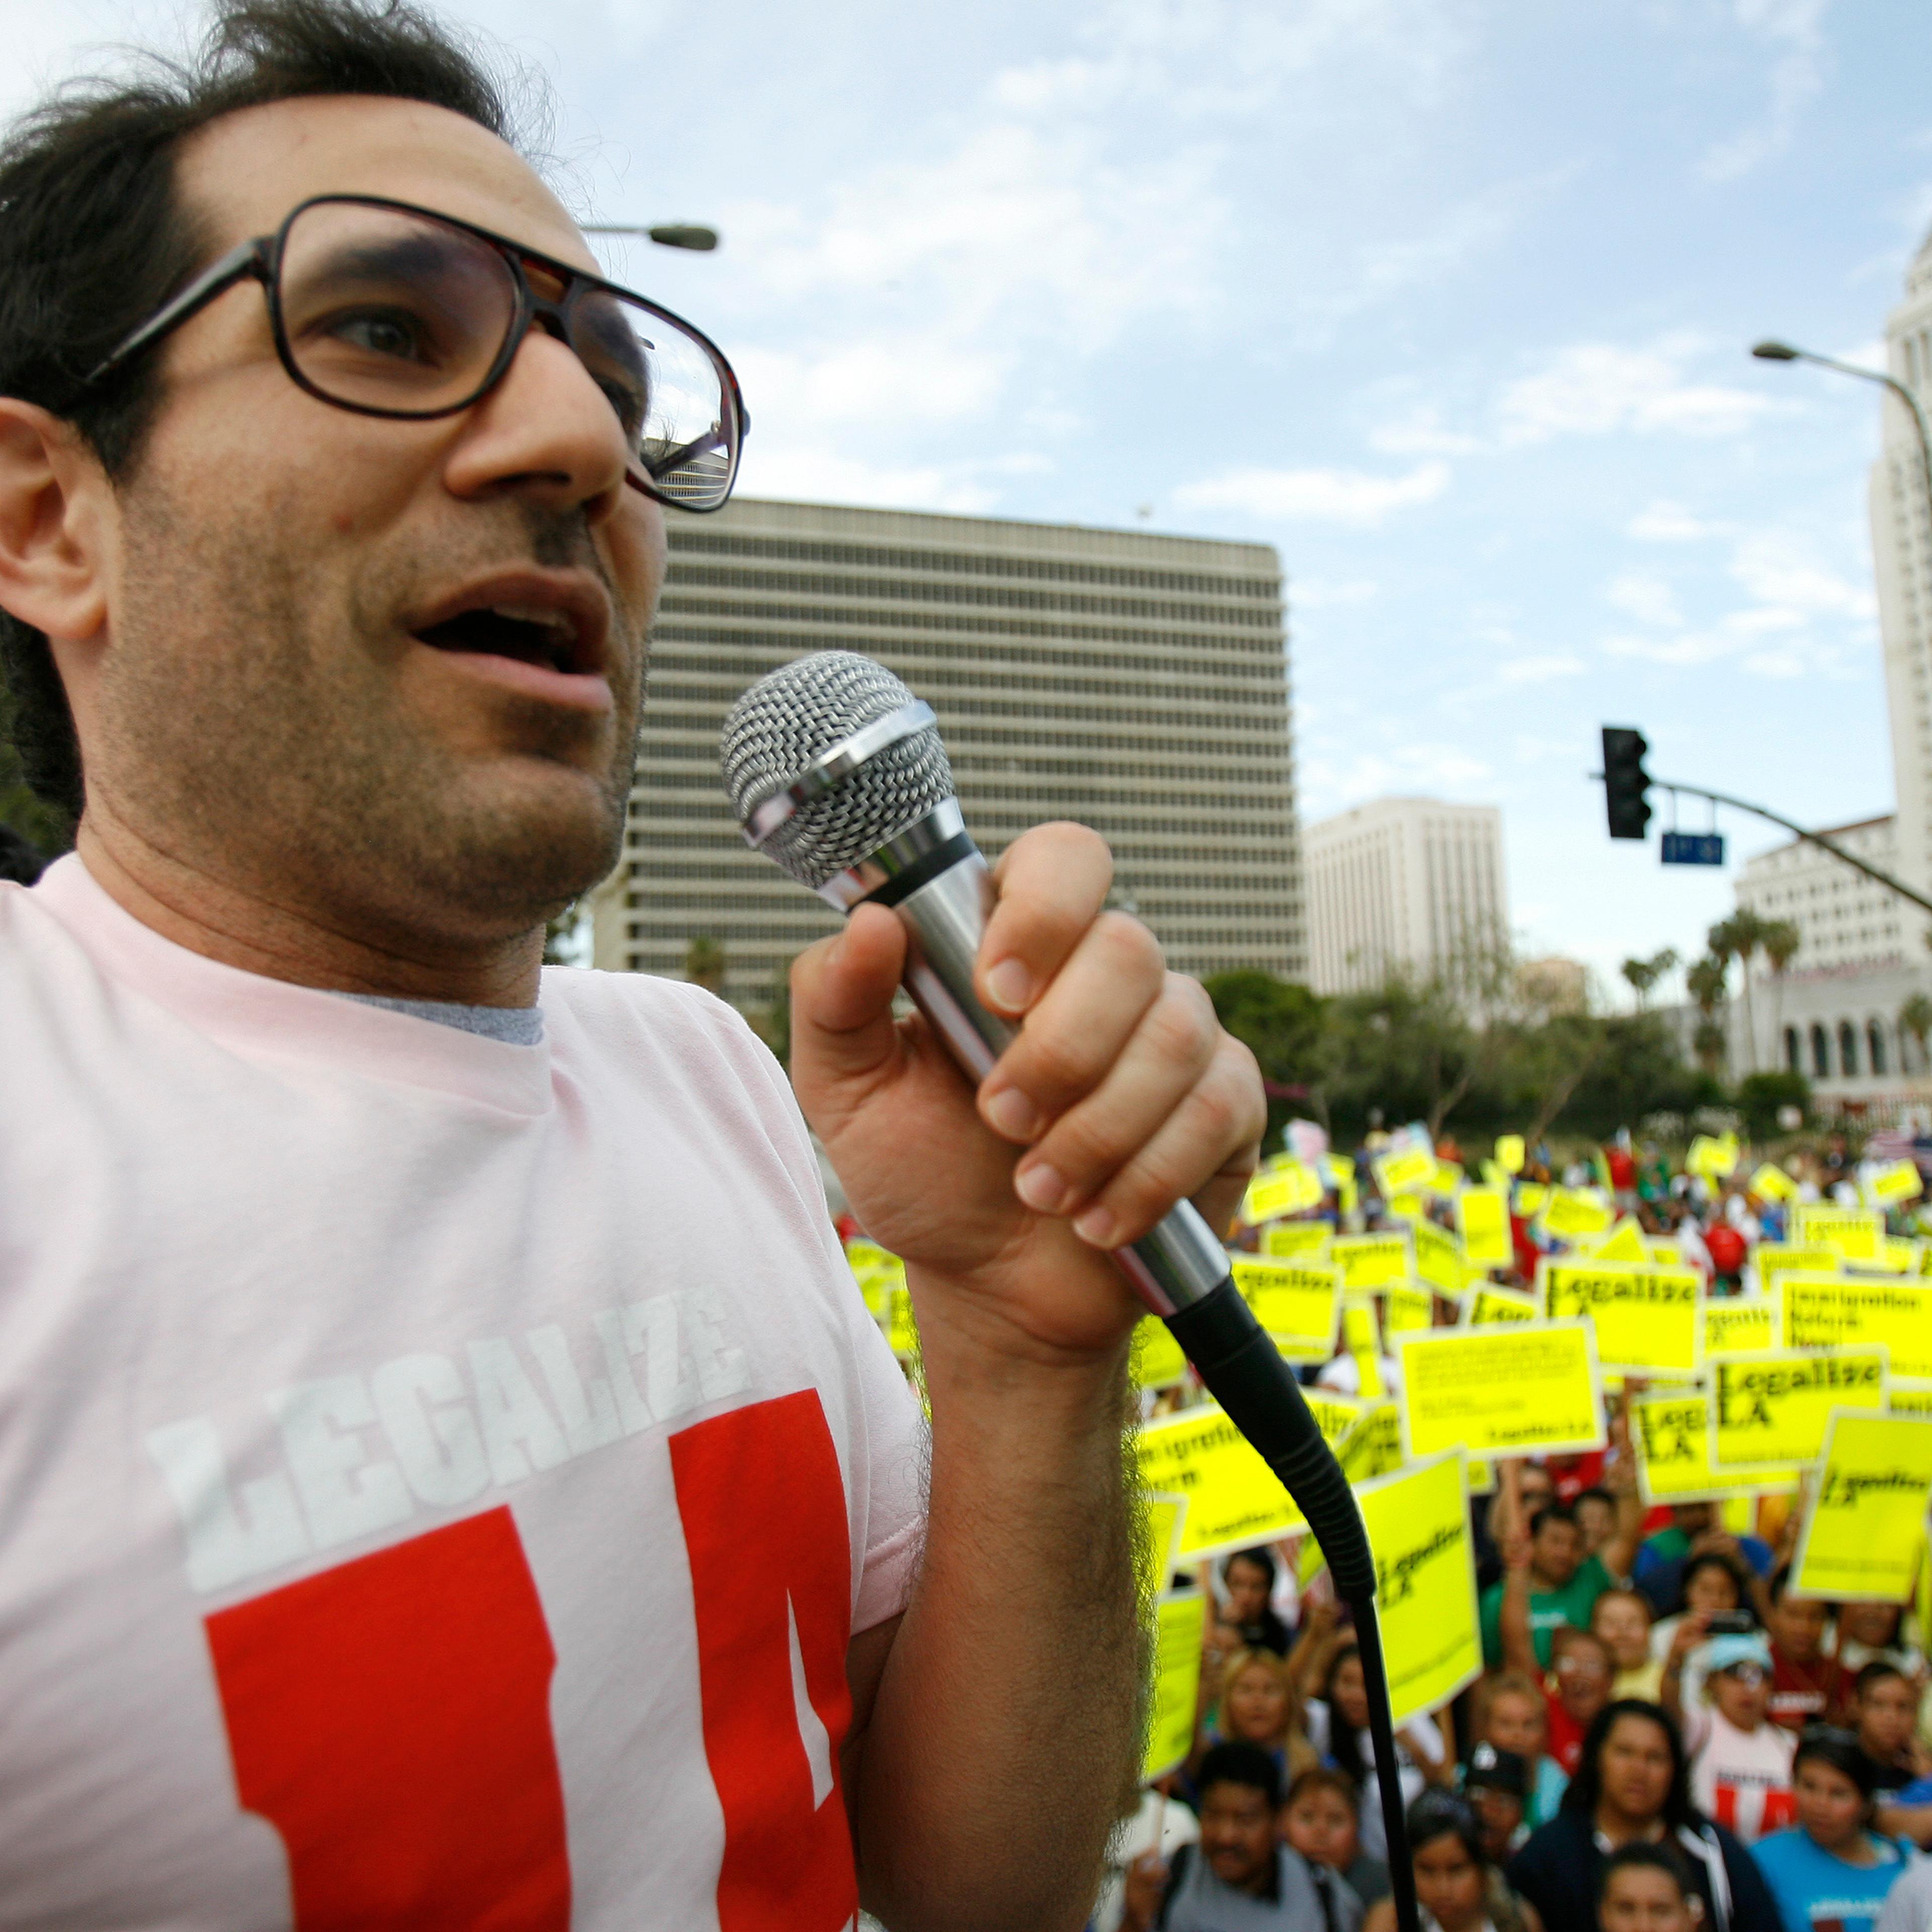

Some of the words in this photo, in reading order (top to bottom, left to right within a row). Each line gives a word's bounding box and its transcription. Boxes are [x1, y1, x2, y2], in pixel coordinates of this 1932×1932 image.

[1546, 1267, 1698, 1304] Legalize
[1719, 1357, 1881, 1396] Legalize
[144, 1286, 756, 1594] LEGALIZE
